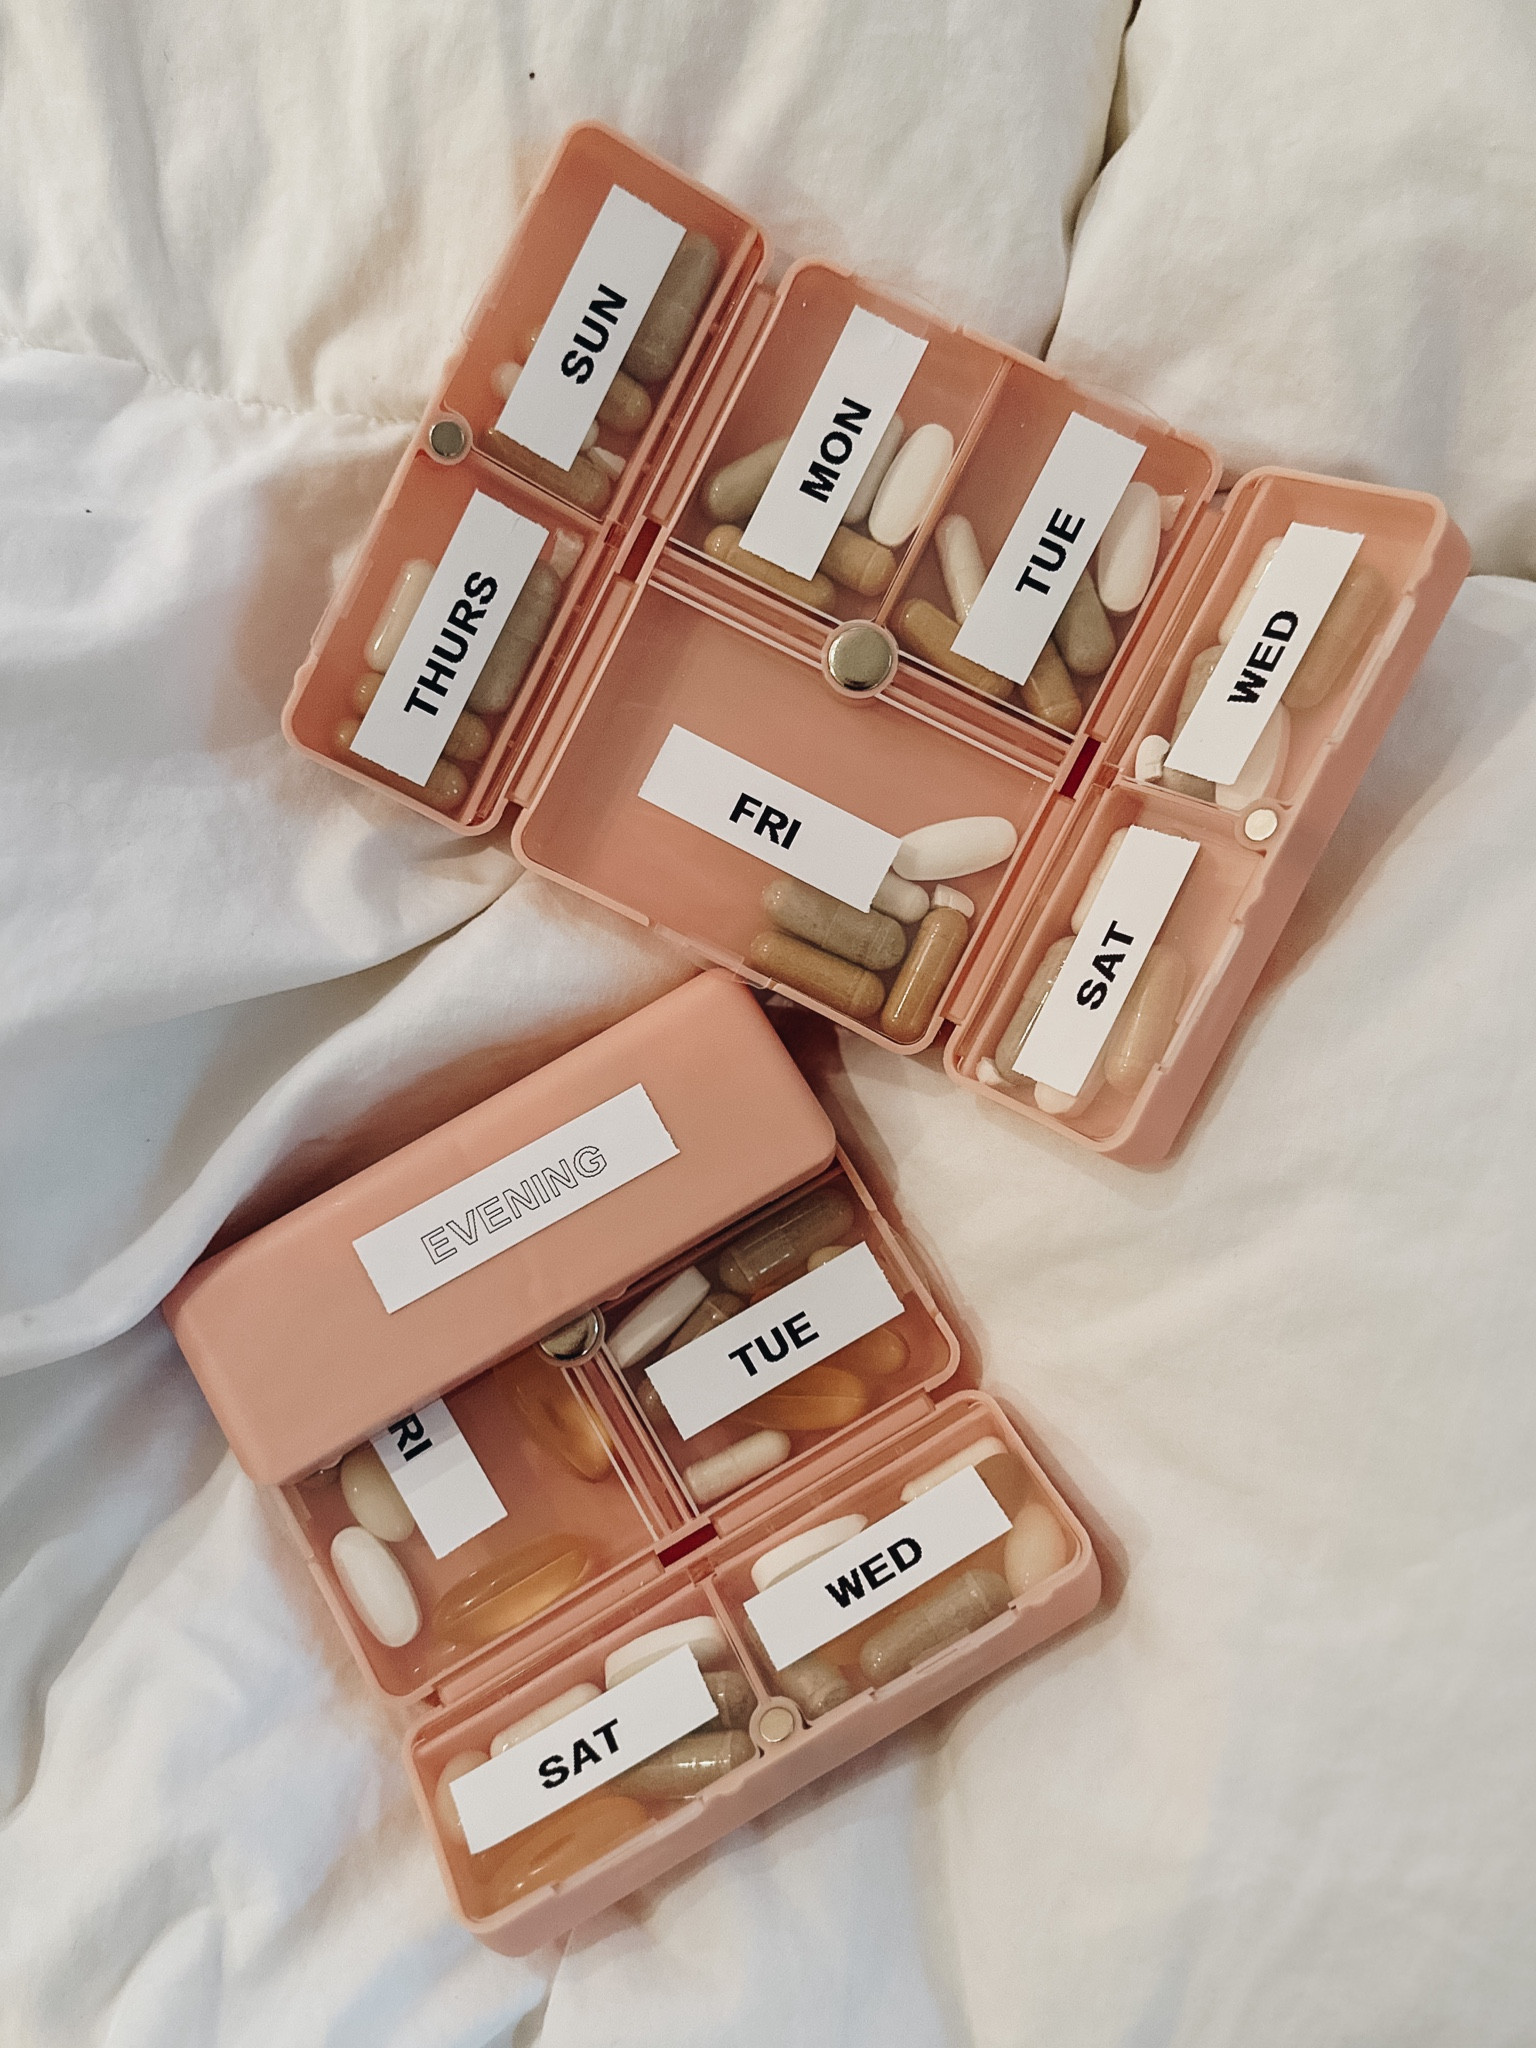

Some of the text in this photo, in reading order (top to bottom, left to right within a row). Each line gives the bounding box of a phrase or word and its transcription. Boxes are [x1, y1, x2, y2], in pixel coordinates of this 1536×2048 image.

[560, 283, 628, 385] SUN
[799, 396, 872, 503] MON
[1015, 507, 1086, 595] TUE
[403, 571, 498, 717] THURS
[1226, 610, 1300, 704] WED
[729, 792, 802, 850] FRI
[1076, 920, 1135, 1011] SAT
[420, 1145, 608, 1265] EVENING
[727, 1311, 820, 1377] TUE
[387, 1412, 433, 1462] RI
[824, 1537, 923, 1609] WED
[538, 1718, 622, 1789] SAT
